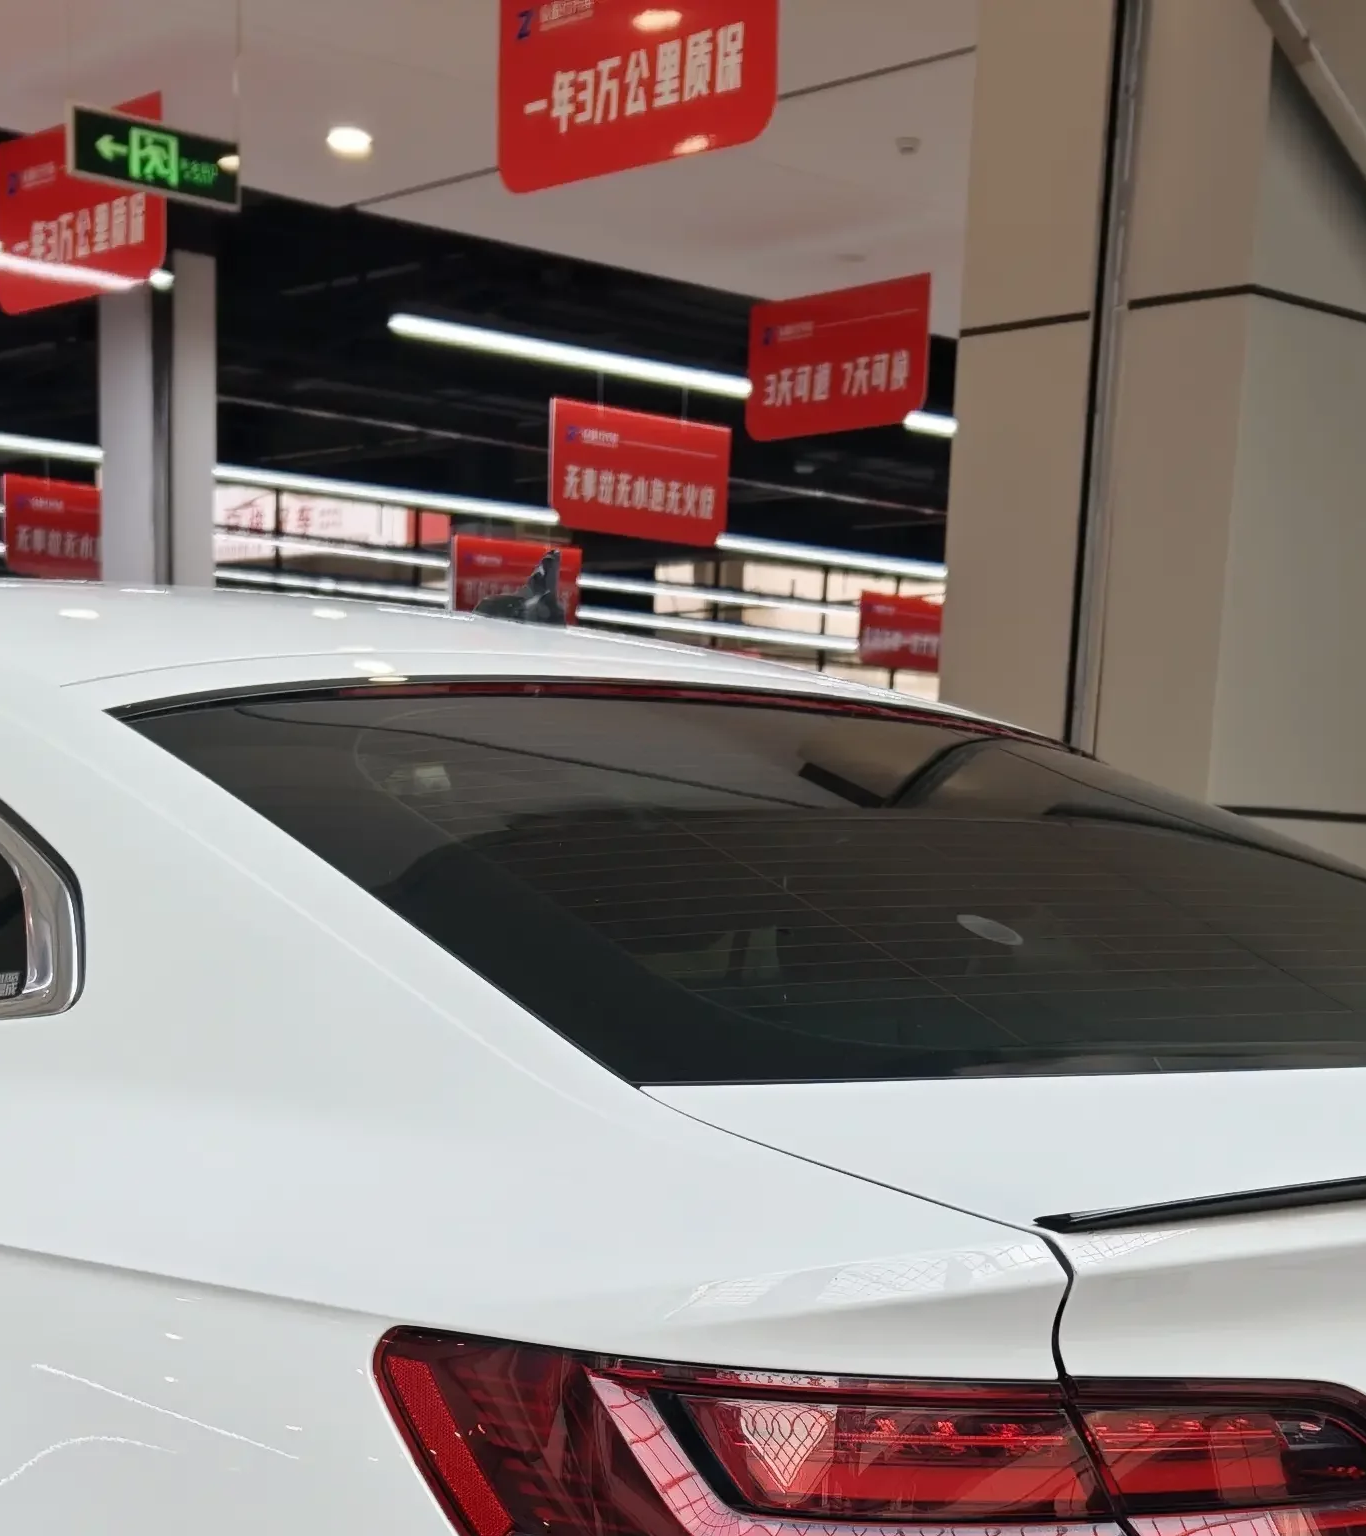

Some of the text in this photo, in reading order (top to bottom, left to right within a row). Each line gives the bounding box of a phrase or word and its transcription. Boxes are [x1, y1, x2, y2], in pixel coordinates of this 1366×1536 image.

[524, 21, 745, 133] 一年3万公里质保
